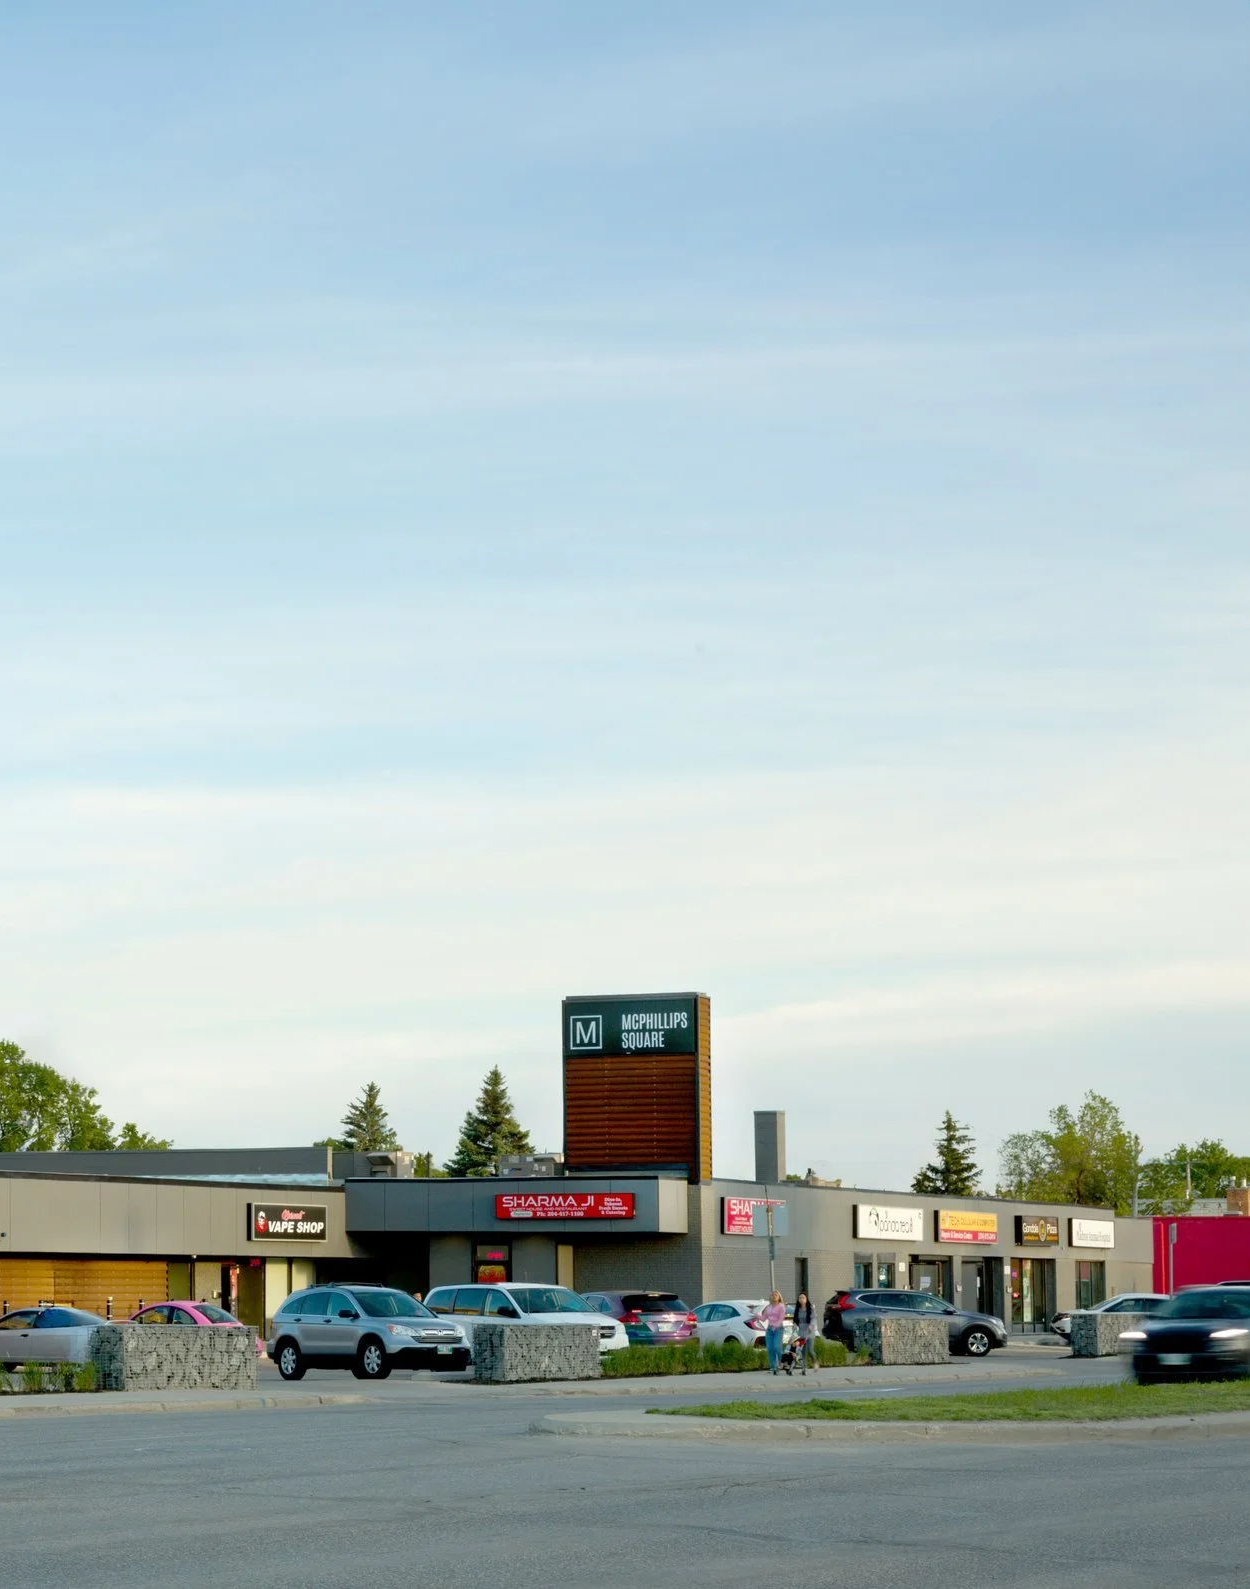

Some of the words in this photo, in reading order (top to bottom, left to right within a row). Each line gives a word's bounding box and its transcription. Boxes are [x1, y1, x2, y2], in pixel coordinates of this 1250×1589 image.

[622, 1012, 688, 1030] MCPHILLIPS
[576, 1021, 596, 1044] M
[622, 1032, 664, 1050] SQUARE
[502, 1196, 578, 1207] SHARMA
[581, 1196, 594, 1207] JI
[268, 1221, 294, 1233] VAPE
[296, 1221, 324, 1233] SHOP
